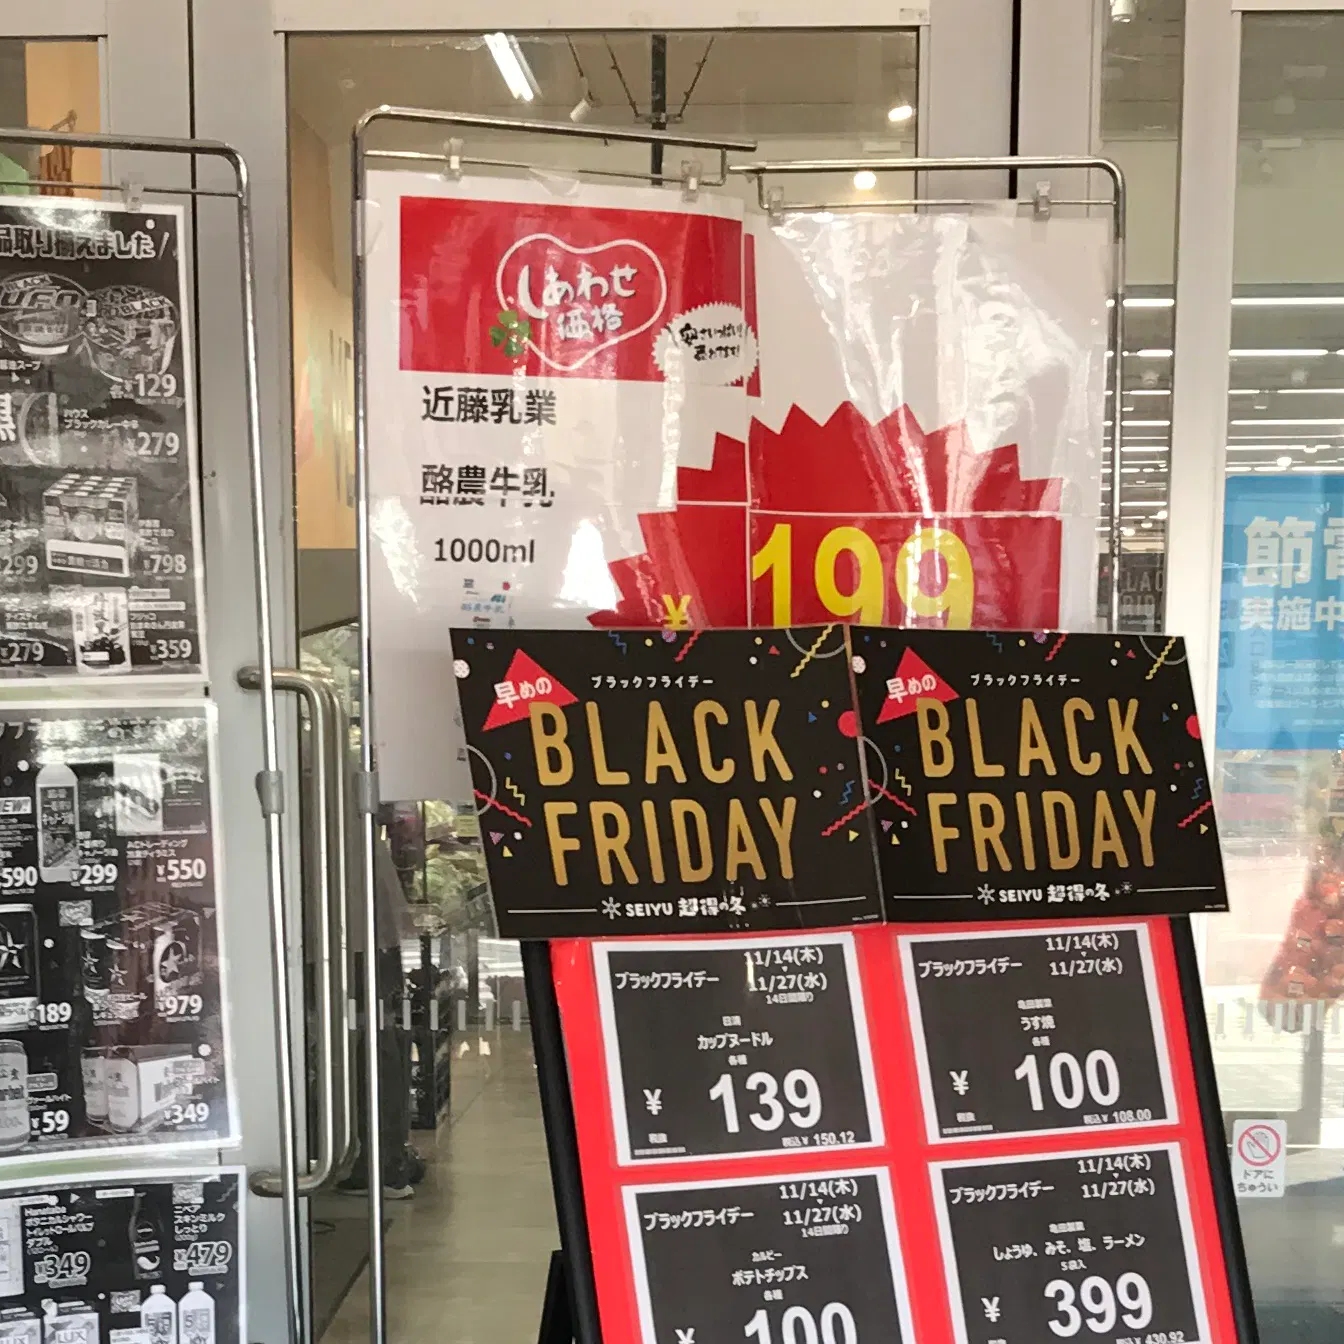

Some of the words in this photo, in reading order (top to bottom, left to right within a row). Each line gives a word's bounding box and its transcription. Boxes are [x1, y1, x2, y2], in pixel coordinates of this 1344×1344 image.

[420, 385, 557, 426] 近藤乳業
[434, 537, 535, 565] 1000ml
[752, 523, 974, 629] 199
[494, 674, 553, 708] 早めの
[592, 673, 714, 690] ブラックフライデー
[886, 673, 936, 703] 早めの
[970, 672, 1080, 688] ブラックフライデー
[530, 698, 793, 787] BLACK
[916, 696, 1153, 779] BLACK
[544, 796, 799, 887] FRIDAY
[932, 788, 1157, 876] FRIDAY
[999, 888, 1043, 904] SEIYU
[624, 900, 674, 919] SEIYU
[1045, 933, 1119, 952] 11/14(木)
[918, 957, 1023, 978] ブラックフライデー
[1049, 957, 1123, 977] 11/27(水)
[615, 971, 719, 989] ブラックフライデー
[1020, 1015, 1056, 1031] うす焼
[697, 1032, 773, 1050] カップヌードル
[1015, 1050, 1121, 1112] 100
[709, 1069, 823, 1134] 139
[1112, 1108, 1152, 1123] 108.00
[813, 1131, 855, 1145] 150.12
[1077, 1153, 1152, 1175] 11/14(木)
[779, 1178, 858, 1201] 11/14(木)
[949, 1180, 1055, 1205] ブラックフライデー
[1081, 1177, 1155, 1199] 11/27(水)
[643, 1206, 754, 1231] ブラックフライデー
[783, 1204, 862, 1227] 11/27(水)
[732, 1265, 809, 1286] ポテトチップス
[1044, 1272, 1154, 1338] 399
